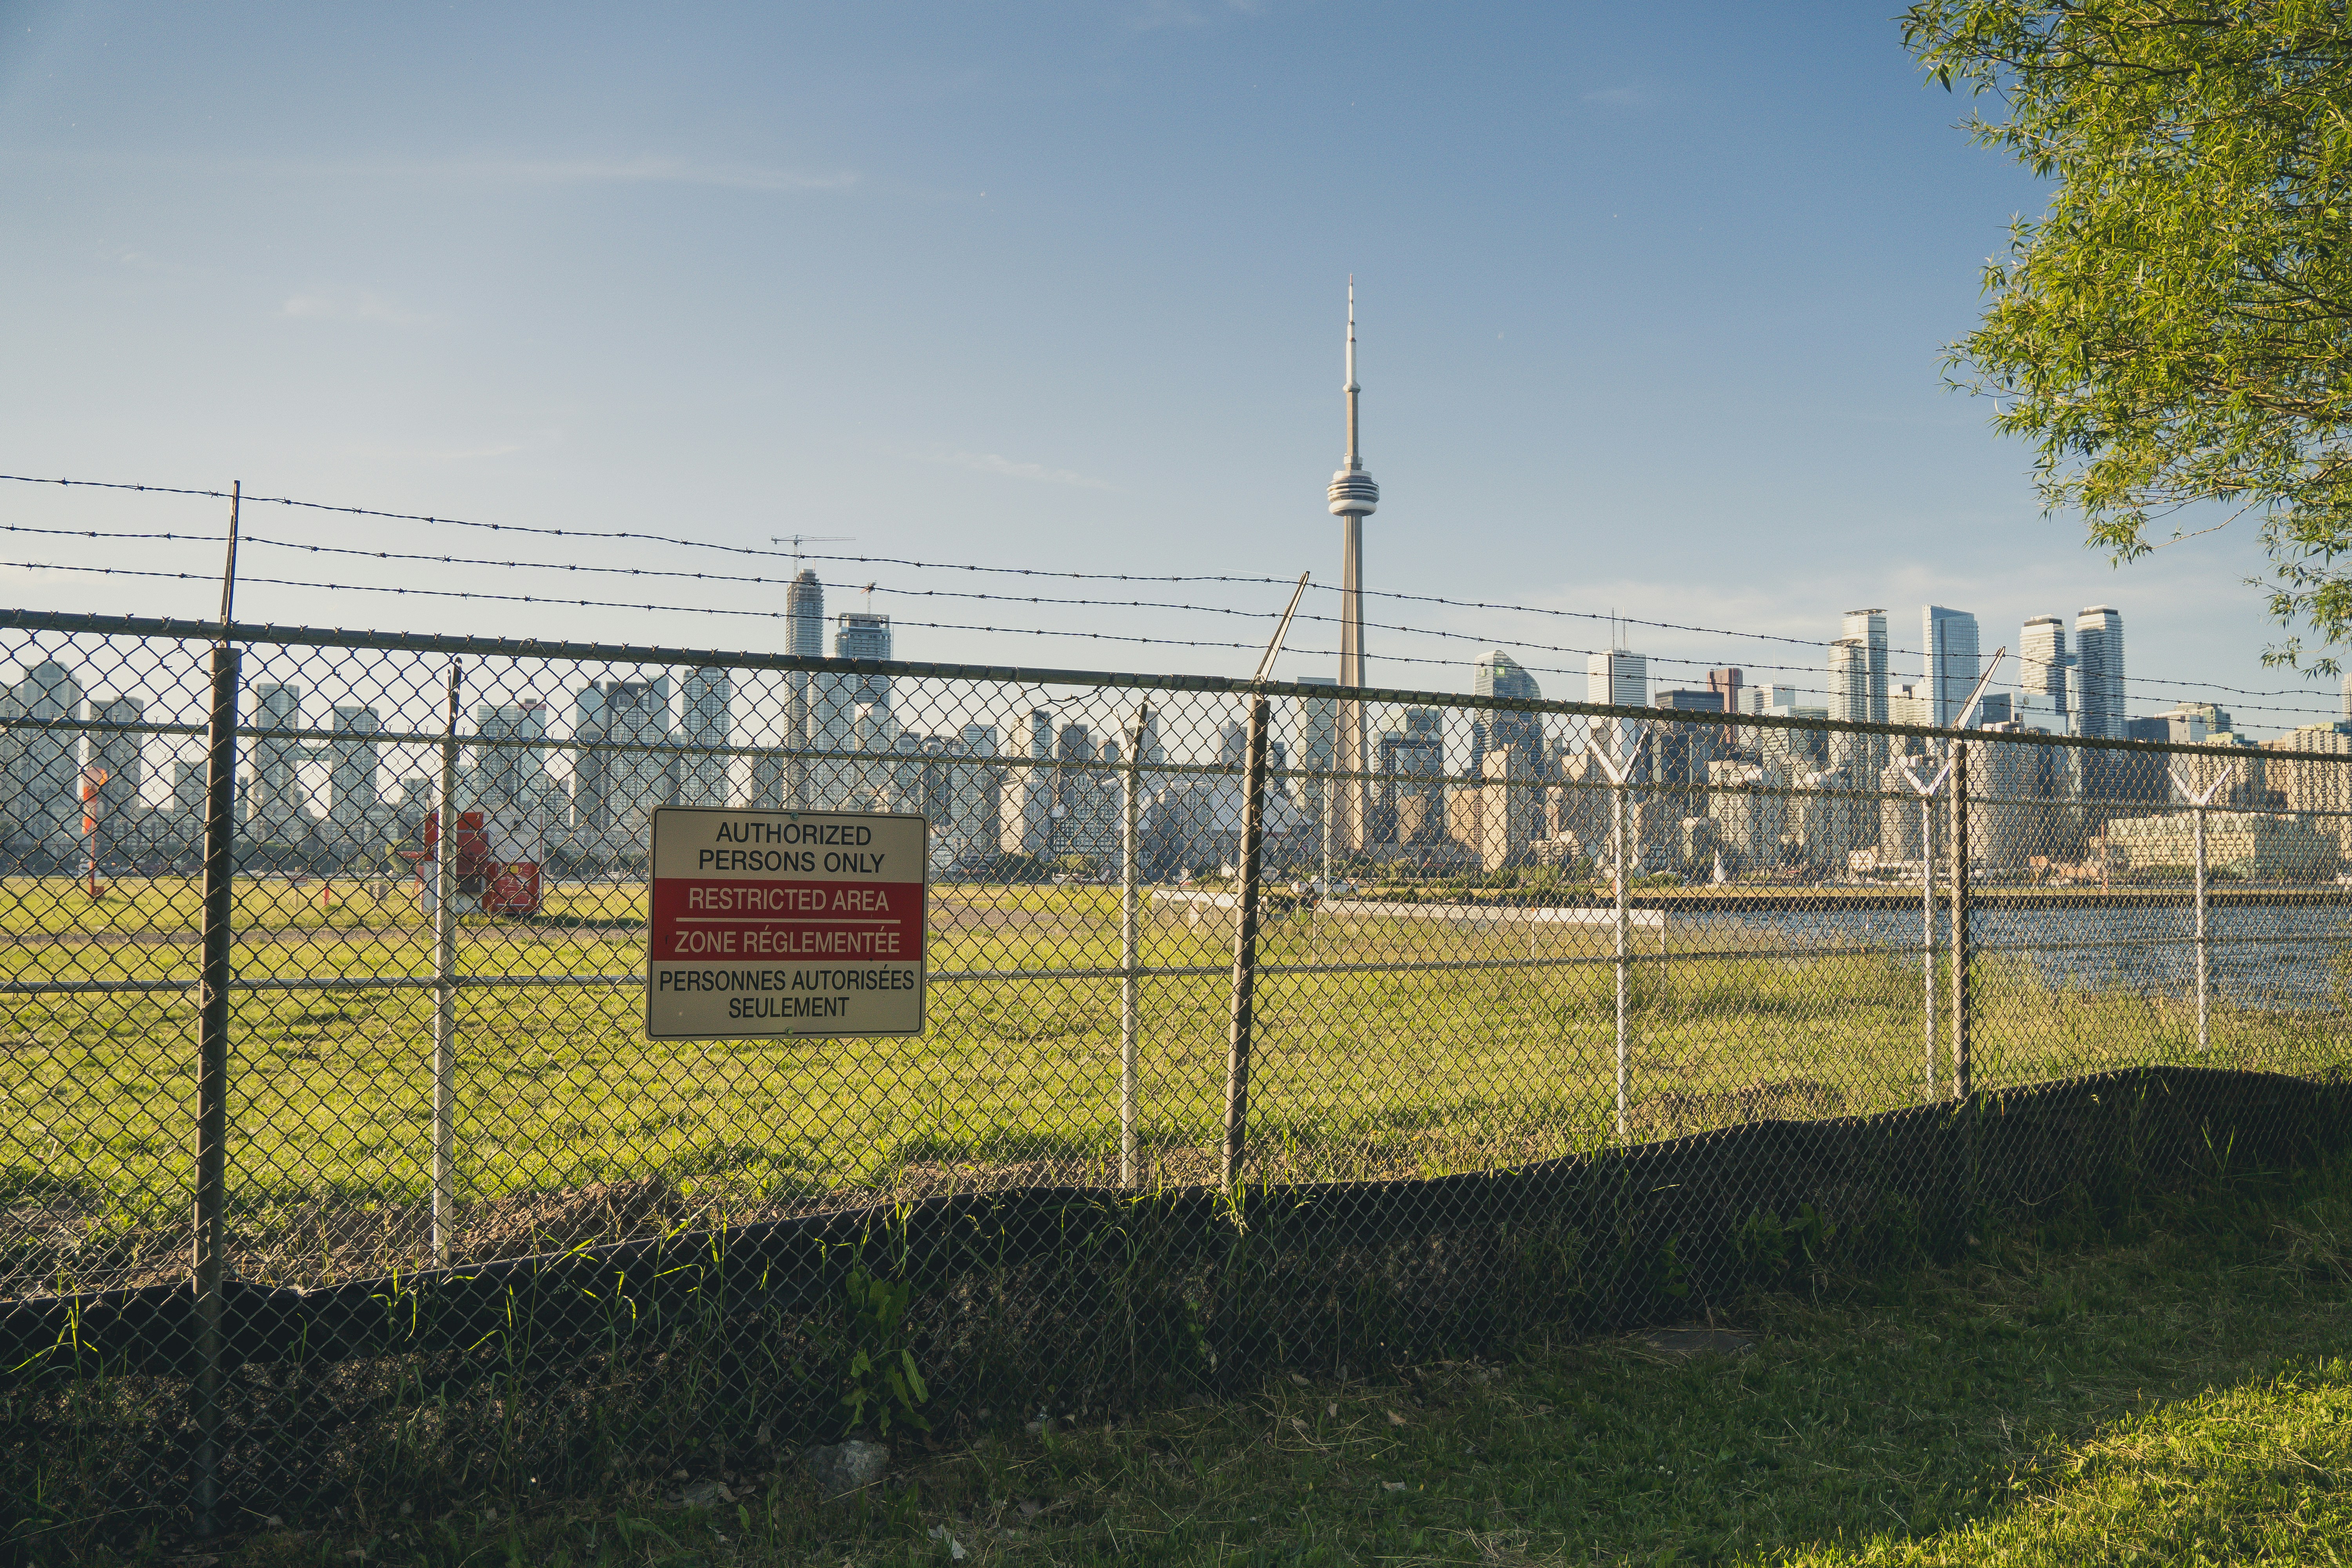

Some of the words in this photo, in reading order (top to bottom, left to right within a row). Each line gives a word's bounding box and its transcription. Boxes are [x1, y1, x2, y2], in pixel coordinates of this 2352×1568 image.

[716, 822, 871, 846] AUTHORIZED
[699, 849, 815, 872] PERSONS
[824, 852, 885, 873] ONLY
[689, 887, 826, 910] RESTRICTED
[832, 890, 889, 911] AREA
[675, 931, 736, 953] ZONE
[744, 925, 900, 953] RÉGLEMENTÉE
[660, 970, 786, 991] PERSONNES
[791, 964, 914, 990] AUTORISÉES
[729, 997, 849, 1018] SEULEMENT
